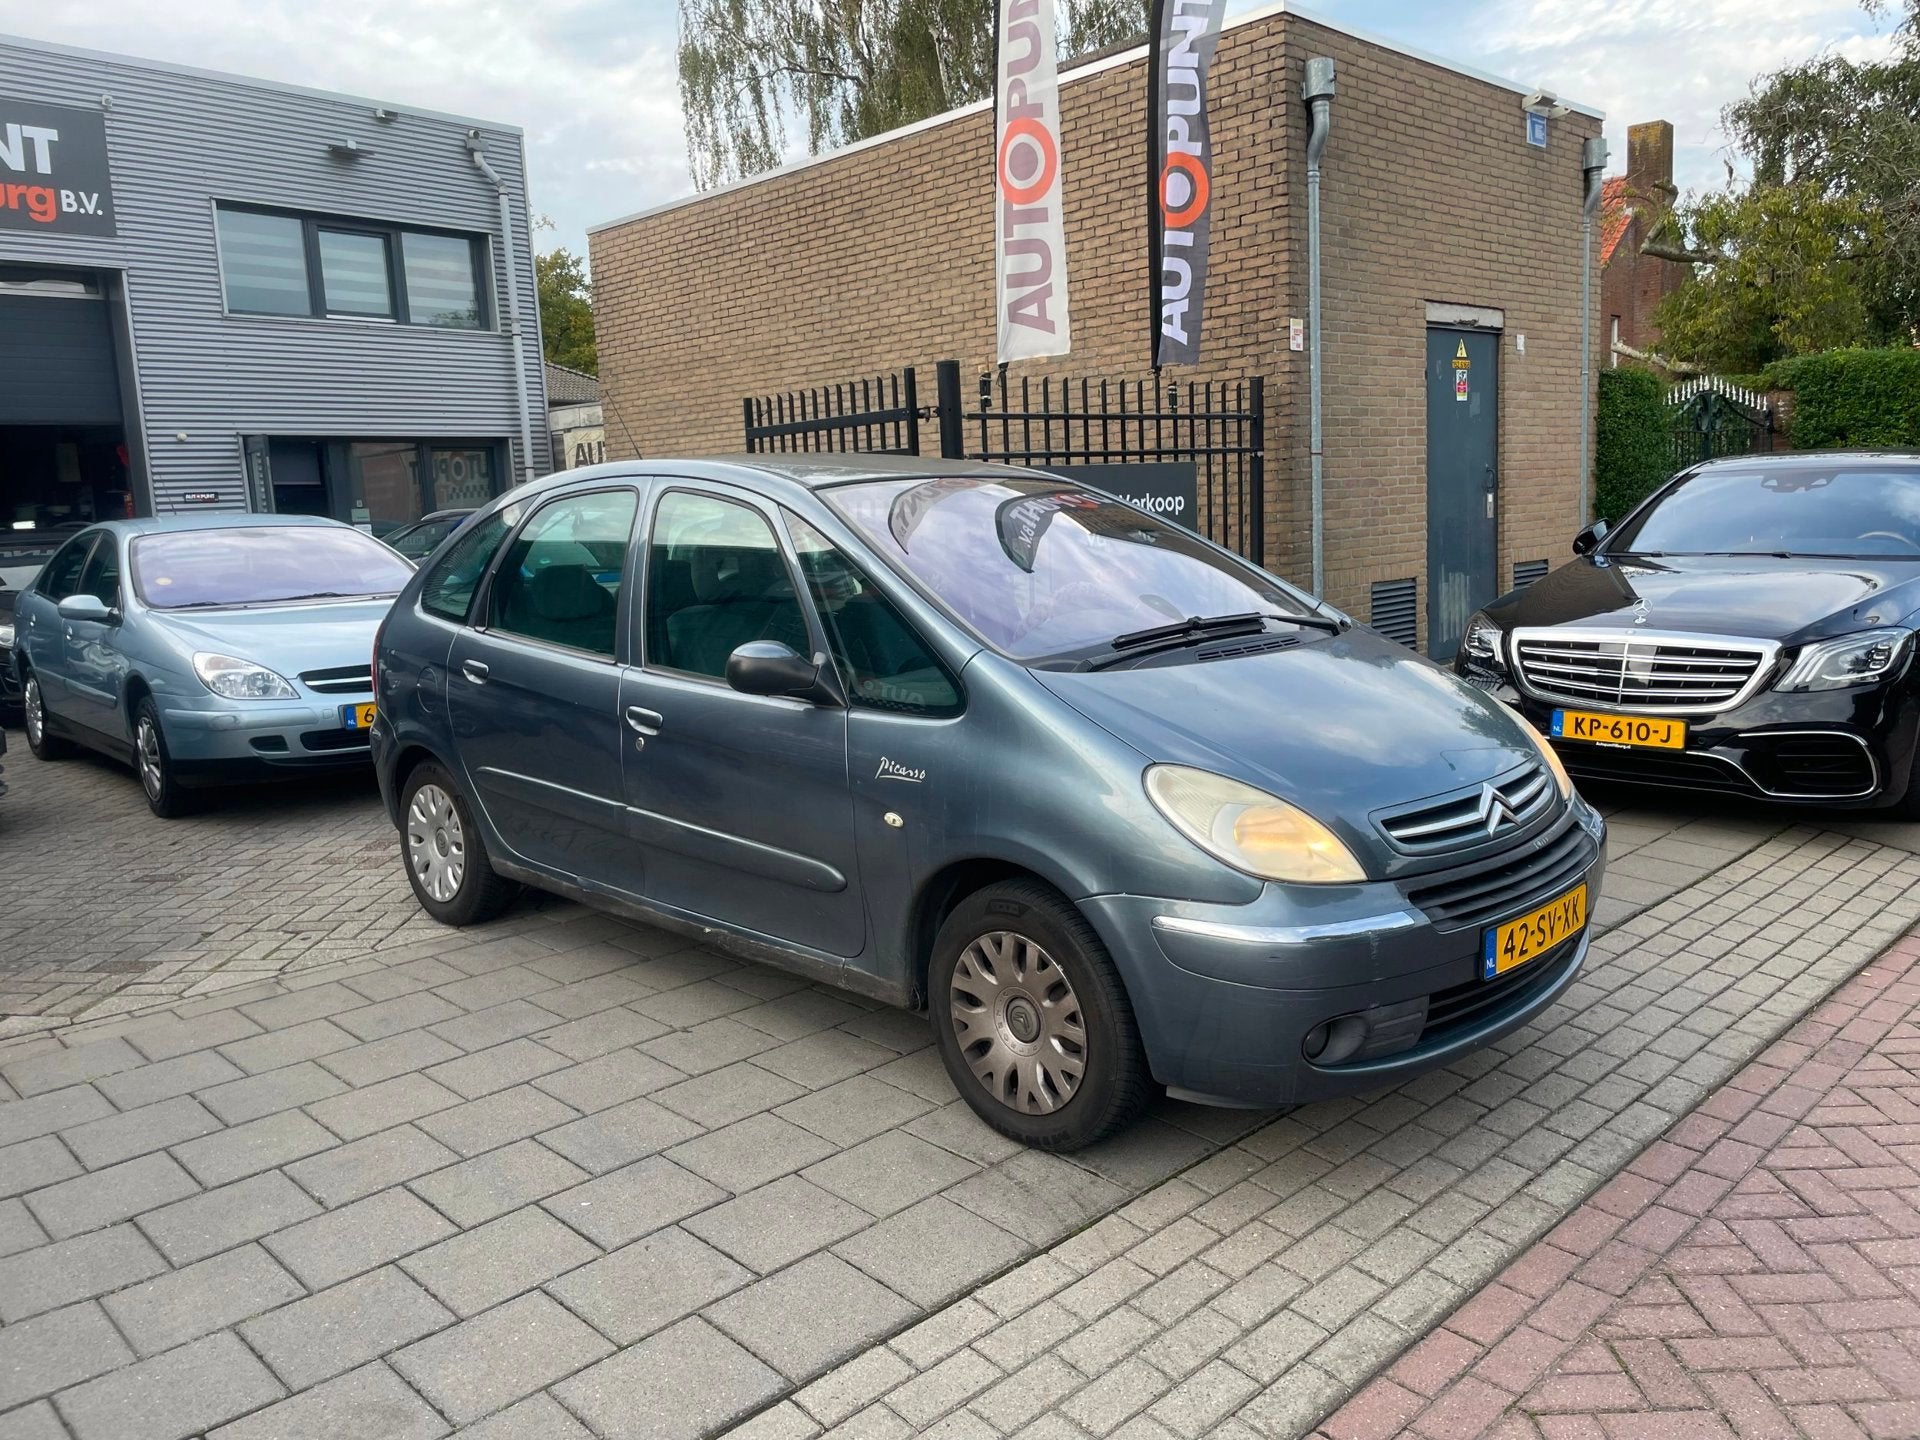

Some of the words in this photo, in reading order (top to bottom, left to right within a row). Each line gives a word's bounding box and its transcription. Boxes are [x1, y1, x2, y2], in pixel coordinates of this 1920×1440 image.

[0, 183, 57, 223] rg
[60, 189, 103, 216] B.V.
[575, 440, 606, 468] AU
[364, 707, 375, 723] 6
[1552, 724, 1562, 732] NL
[1574, 716, 1671, 743] KP-610-J
[875, 756, 926, 781] Picasso
[1486, 957, 1496, 970] NL
[1503, 893, 1580, 961] 42-SV-XK
